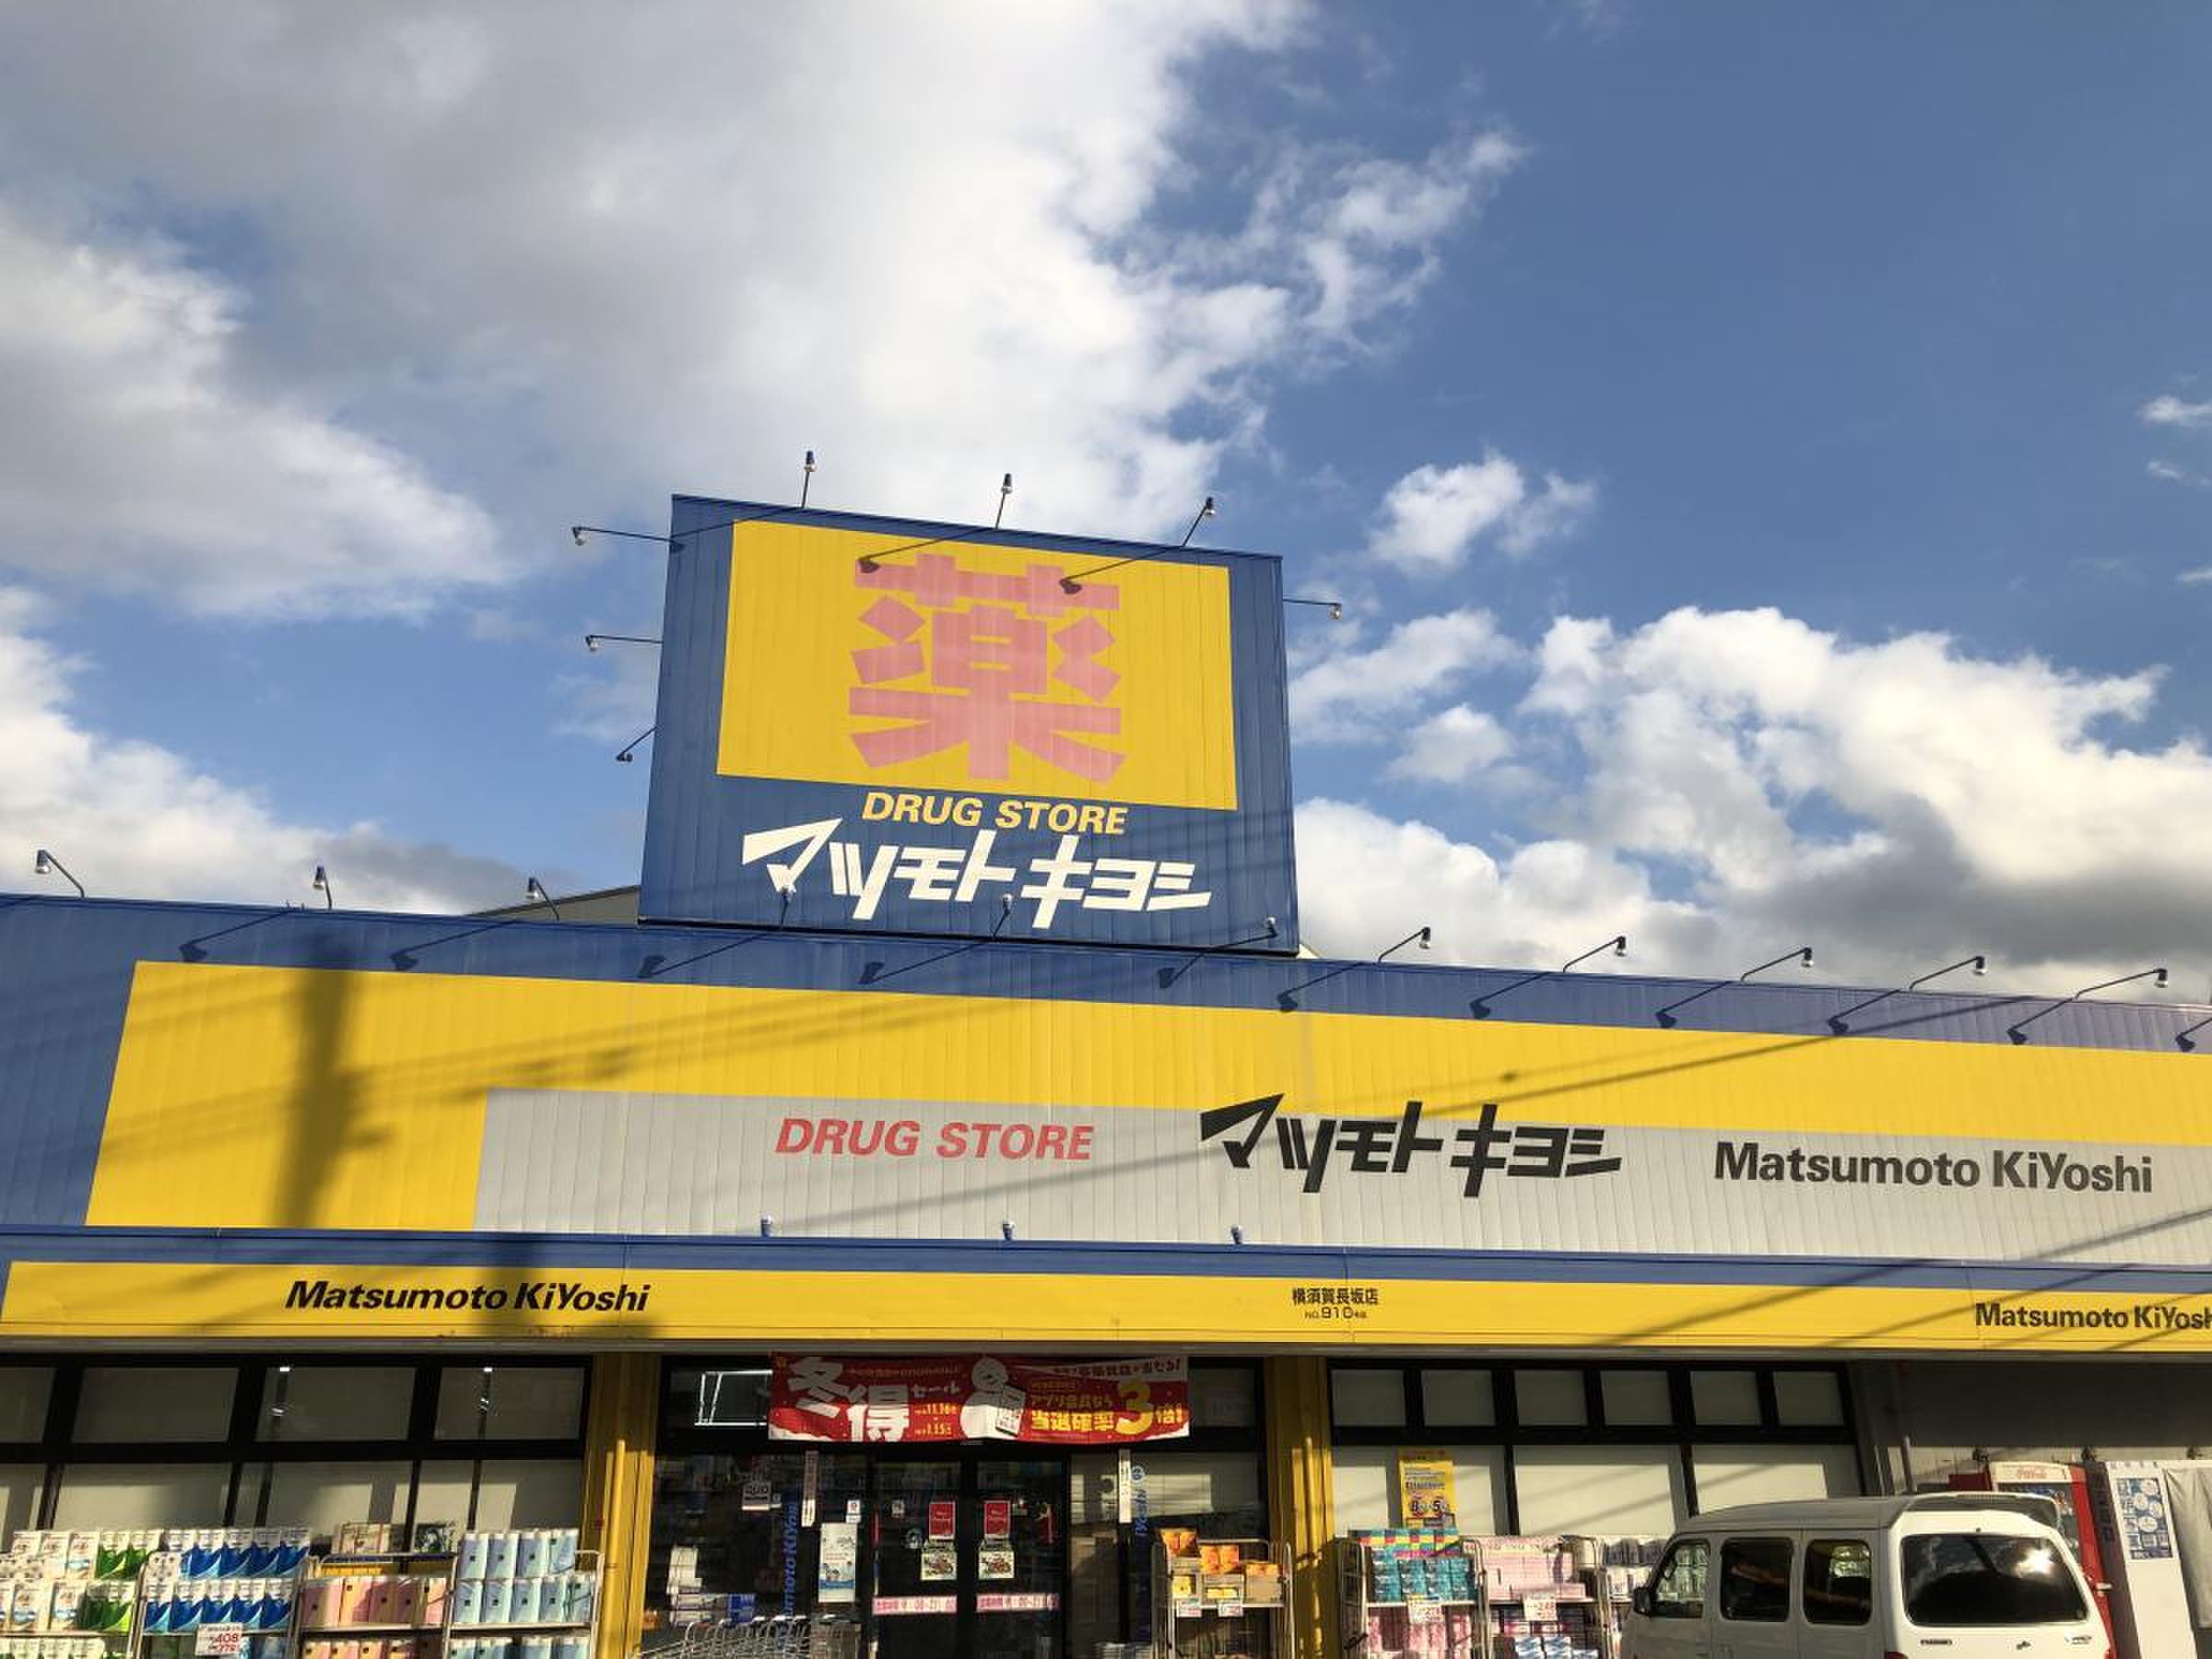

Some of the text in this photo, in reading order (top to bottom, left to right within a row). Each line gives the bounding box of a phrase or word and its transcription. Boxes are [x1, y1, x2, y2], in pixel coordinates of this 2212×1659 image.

[849, 553, 1126, 783] 薬
[863, 793, 1128, 835] DRUG STORE
[742, 818, 1212, 930] マツモトキヨシ
[775, 1118, 1094, 1160] DRUG STORE
[1200, 1093, 1623, 1197] マツモトキヨシ
[1714, 1142, 2152, 1193] Matsumoto KiYoshi
[285, 1280, 651, 1312] Matsumoto KiYoshi
[1976, 1302, 2129, 1327] Matsumoto
